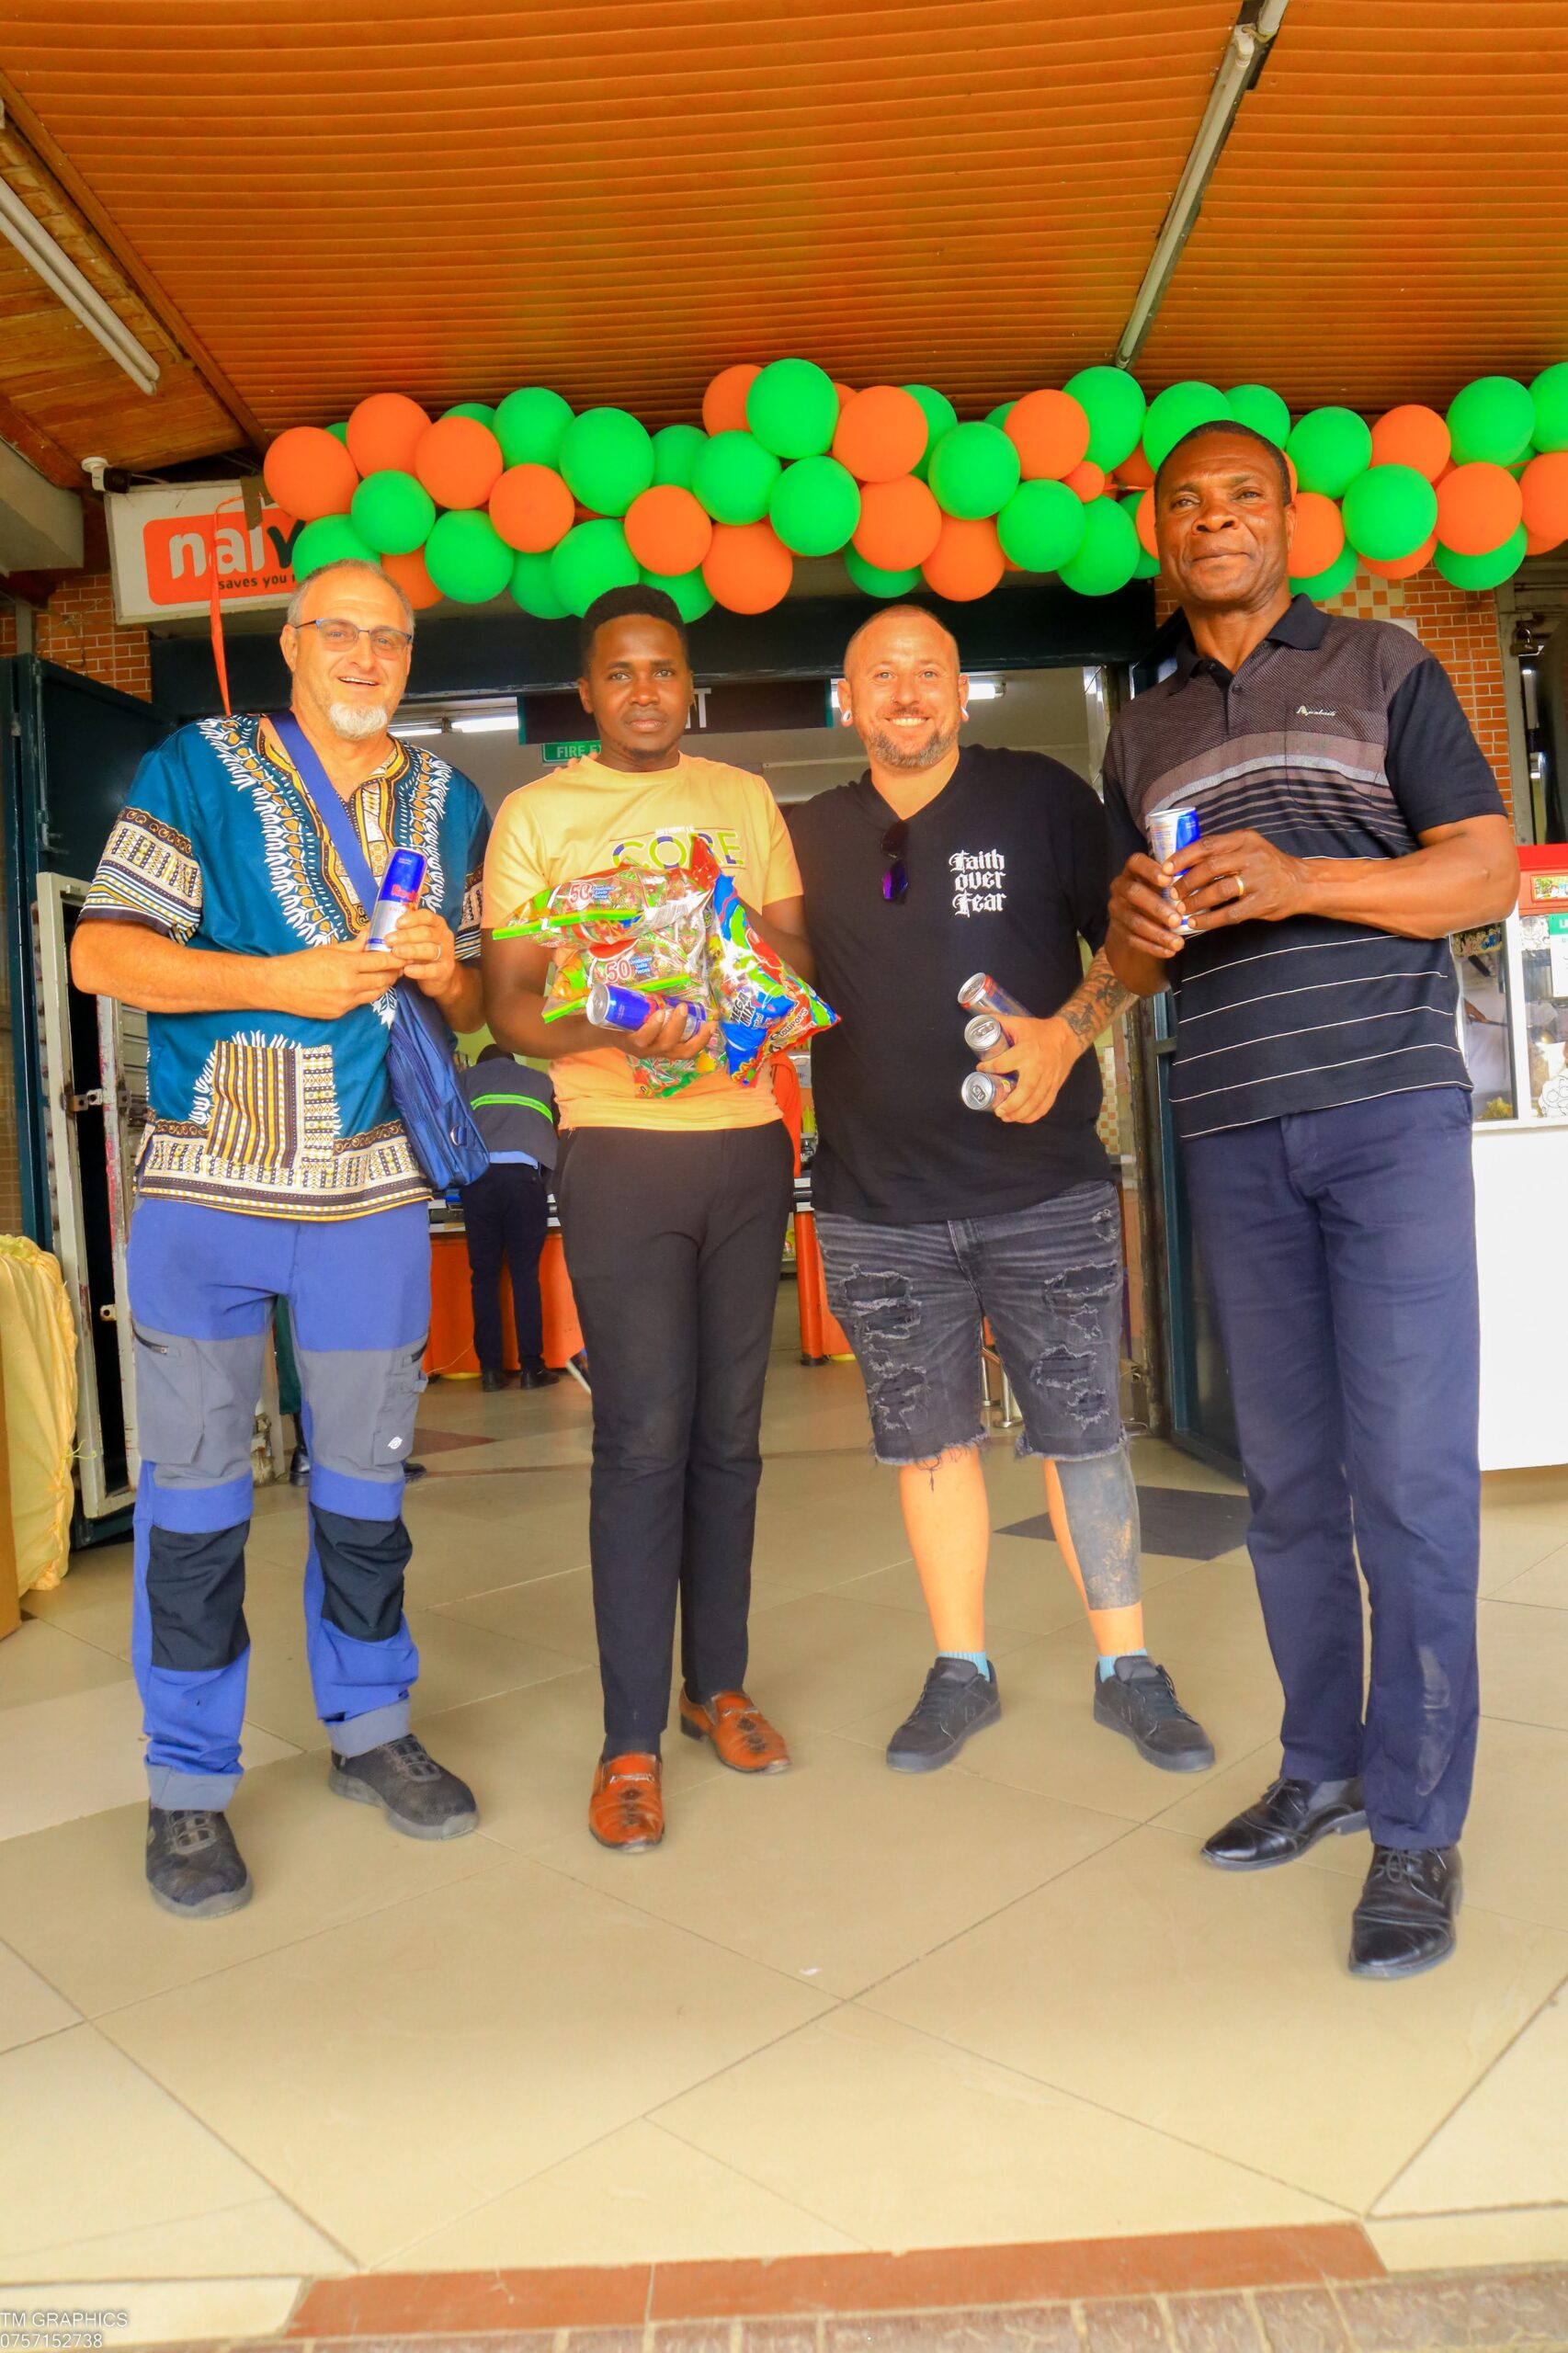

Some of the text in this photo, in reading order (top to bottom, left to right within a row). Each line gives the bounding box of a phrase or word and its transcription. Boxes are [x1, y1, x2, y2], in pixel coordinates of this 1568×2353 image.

[218, 577, 257, 590] saves
[263, 574, 288, 589] you
[556, 745, 585, 758] FIRE
[949, 848, 1006, 873] Faith
[955, 870, 1006, 892] over
[952, 889, 1007, 918] Fear
[605, 959, 631, 983] 50
[730, 992, 750, 1023] MEGA
[739, 1001, 756, 1028] MIX
